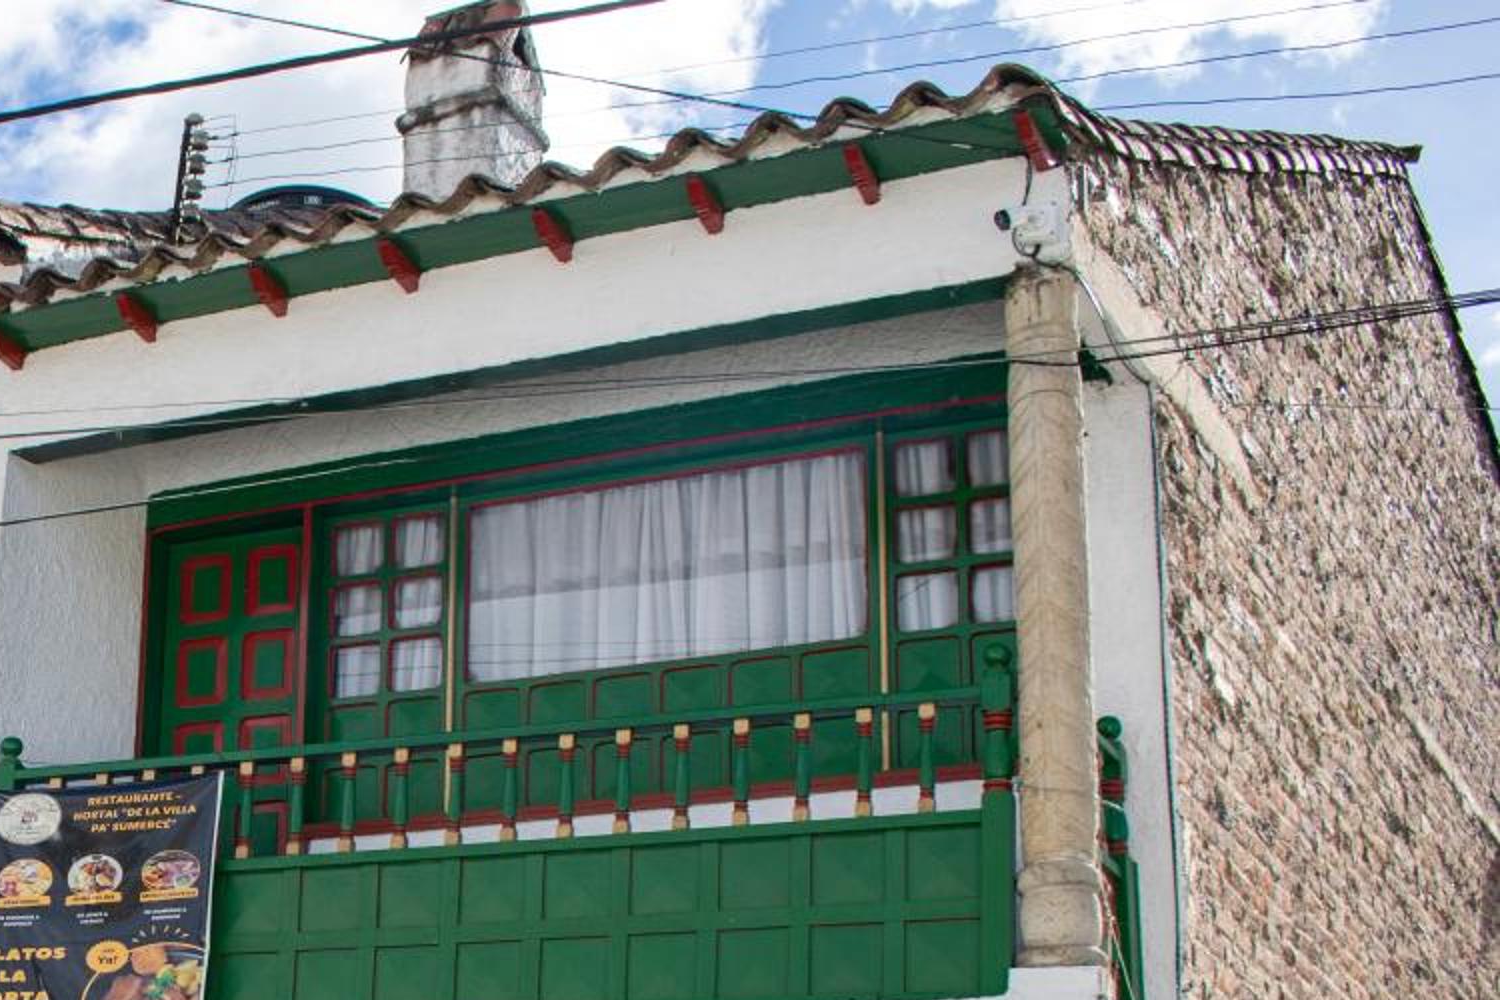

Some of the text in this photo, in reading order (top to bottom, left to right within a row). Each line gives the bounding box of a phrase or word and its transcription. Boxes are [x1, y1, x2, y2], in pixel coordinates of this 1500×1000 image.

[87, 791, 174, 806] RESTAURANTE
[145, 805, 161, 816] LA
[163, 804, 197, 815] VILLA
